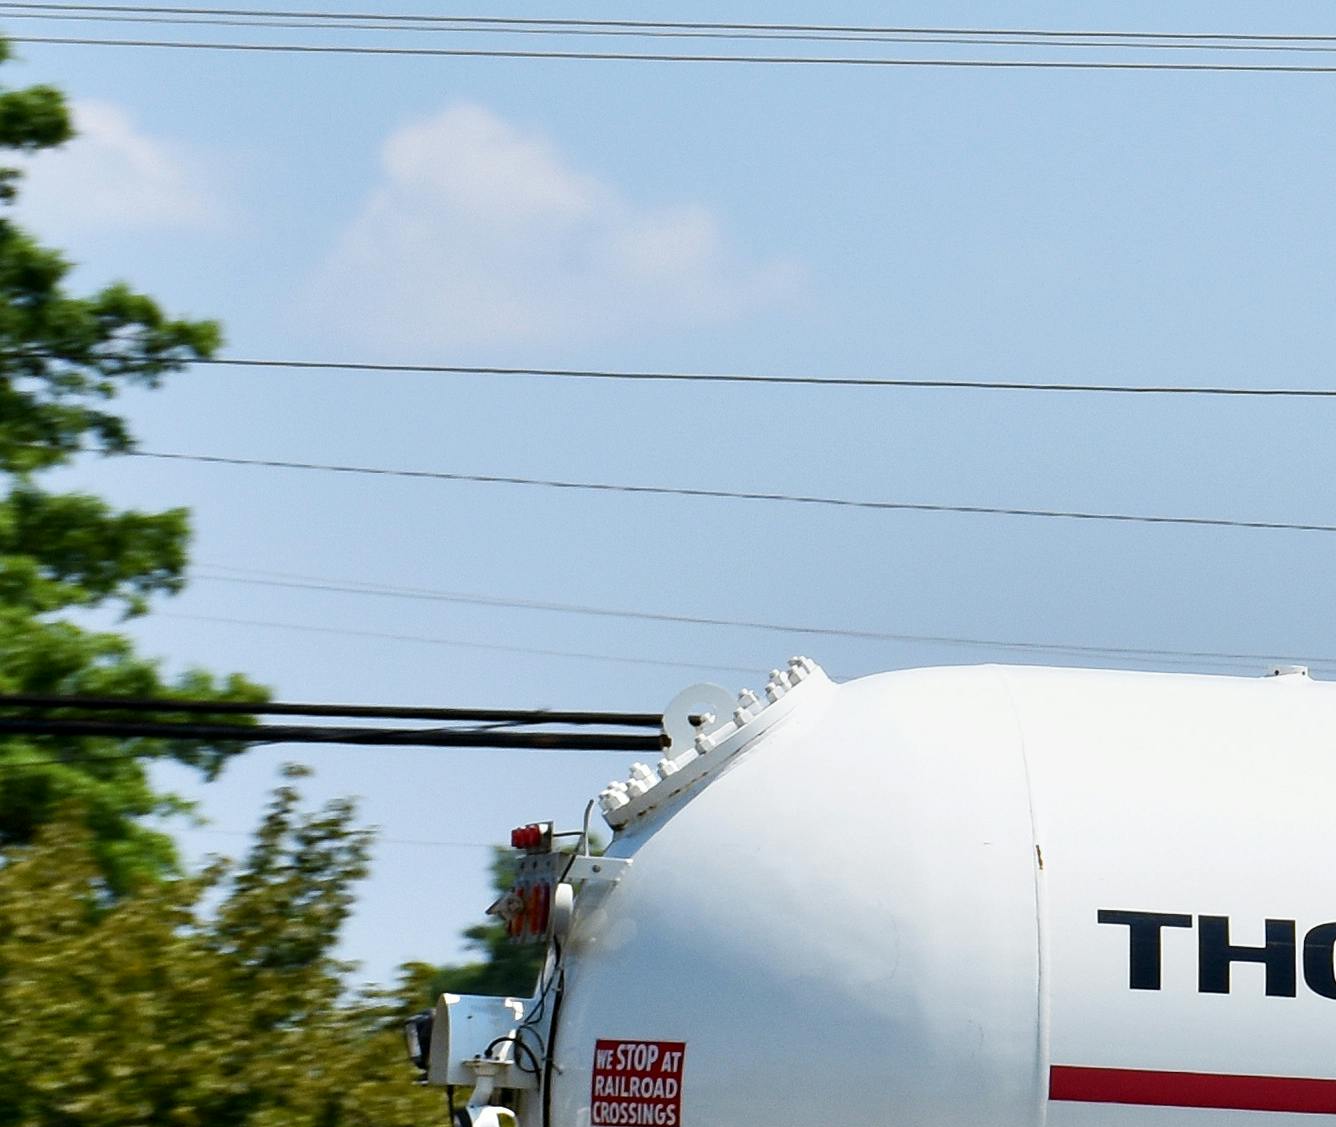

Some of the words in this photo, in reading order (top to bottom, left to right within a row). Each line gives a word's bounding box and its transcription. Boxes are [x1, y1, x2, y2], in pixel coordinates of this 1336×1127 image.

[596, 1049, 614, 1070] WE
[616, 1043, 659, 1071] STOP
[661, 1051, 682, 1072] AT
[594, 1075, 678, 1098] RAILROAD
[593, 1101, 676, 1125] CROSSINGS
